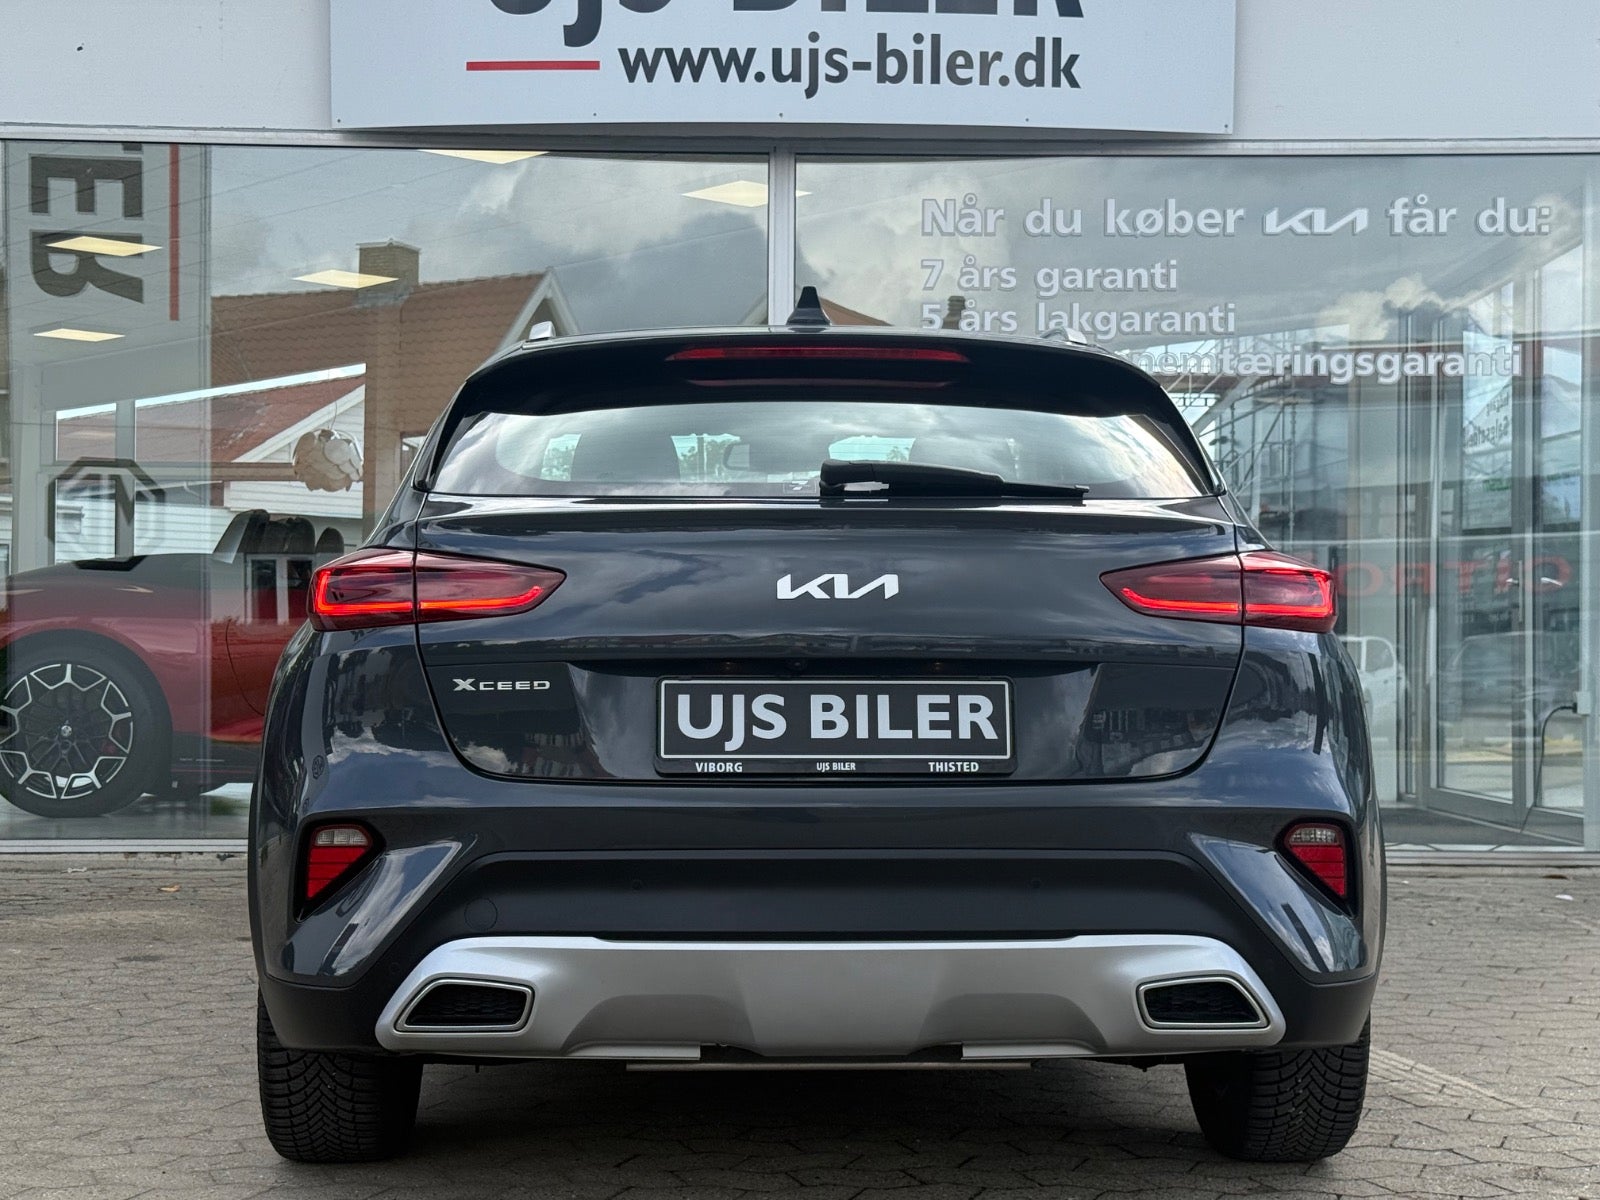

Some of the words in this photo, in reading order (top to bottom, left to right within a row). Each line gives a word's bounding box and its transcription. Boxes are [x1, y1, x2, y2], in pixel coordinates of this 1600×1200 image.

[617, 31, 1081, 99] www.ujs-biler.dk
[921, 193, 1005, 236] Når
[1023, 198, 1082, 236] du
[1104, 198, 1244, 238] køber
[1387, 193, 1457, 235] får
[1476, 197, 1550, 235] du:
[921, 259, 944, 290] 7
[958, 255, 1017, 290] års
[1035, 259, 1178, 298] garanti
[921, 303, 943, 330] 5
[959, 299, 1018, 332] års
[1037, 302, 1236, 340] lakgaranti
[452, 678, 551, 691] XCEED
[676, 694, 788, 751] UJS
[810, 694, 998, 739] BILER
[695, 762, 743, 773] VIBORG
[816, 762, 831, 771] UJS
[832, 762, 856, 771] BILER
[928, 762, 980, 772] THISTED
